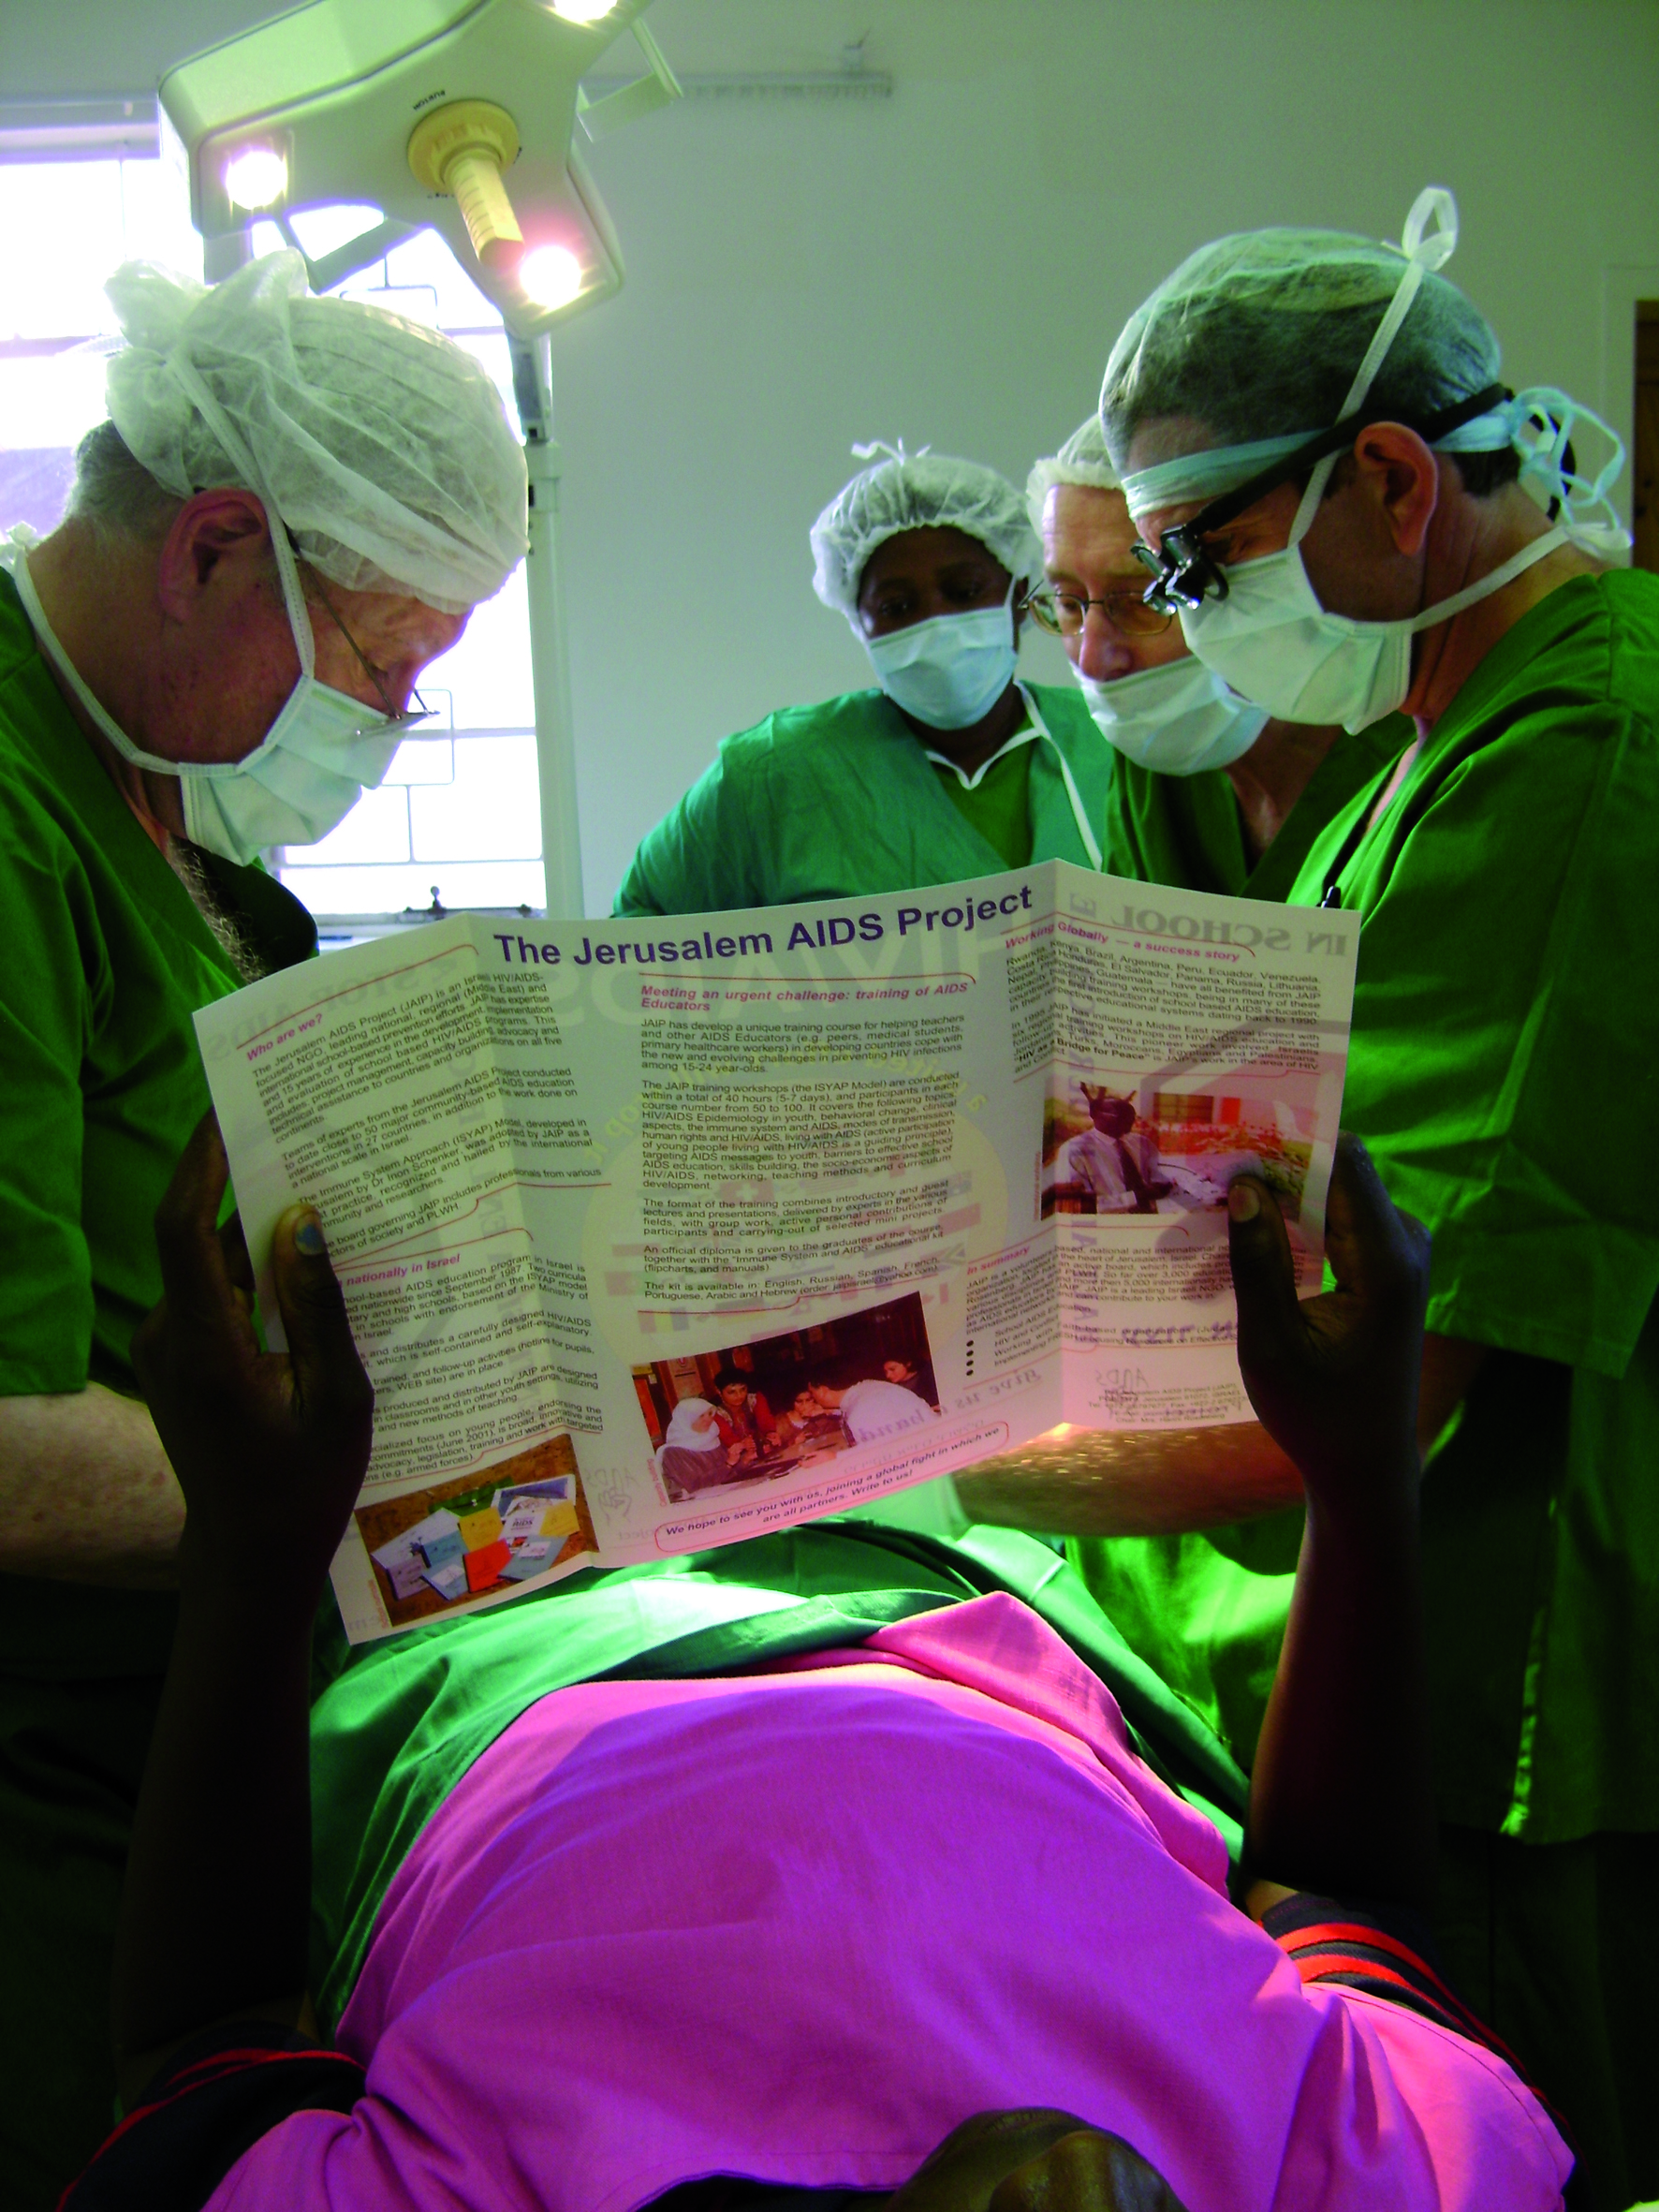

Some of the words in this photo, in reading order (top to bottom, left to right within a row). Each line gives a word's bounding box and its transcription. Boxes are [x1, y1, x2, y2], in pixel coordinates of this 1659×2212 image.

[492, 934, 561, 965] The
[573, 932, 773, 966] Jerusalem
[786, 913, 885, 951] AIDS
[897, 885, 1033, 936] Project
[1006, 926, 1054, 948] Working
[1058, 922, 1108, 944] Globally
[1145, 943, 1200, 957] success
[1204, 950, 1240, 964] story
[507, 995, 550, 1005] expertise
[640, 985, 696, 1000] Meeting
[724, 989, 771, 1002] urgent
[855, 987, 909, 999] training
[915, 985, 930, 995] of
[933, 981, 967, 994] AIDS
[641, 998, 711, 1010] Educators
[253, 1063, 272, 1077] The
[274, 1035, 326, 1066] Jerusalem
[329, 1021, 356, 1039] AIDS
[359, 1007, 397, 1026] Project
[435, 991, 446, 1000] is
[448, 984, 461, 995] an
[492, 972, 543, 981] HIV/AIDS-
[536, 1014, 556, 1023] This
[640, 1019, 666, 1028] JAIP
[668, 1021, 688, 1029] has
[690, 1021, 733, 1033] develop
[743, 1023, 781, 1033] unique
[783, 1023, 823, 1033] training
[880, 1018, 918, 1029] helping
[920, 1015, 964, 1025] teachers
[247, 1041, 273, 1060] Who
[276, 1029, 295, 1045] are
[298, 1014, 322, 1034] we?
[640, 1030, 662, 1039] and
[666, 1031, 695, 1040] other
[699, 1032, 730, 1040] AIDS
[865, 1028, 910, 1039] medical
[640, 1041, 681, 1053] primary
[683, 1042, 741, 1051] healthcare
[801, 1042, 861, 1053] developing
[862, 1040, 912, 1049] countries
[914, 1038, 941, 1047] cope
[942, 1033, 962, 1043] with
[641, 1063, 681, 1072] among
[682, 1062, 713, 1071] 15-24
[526, 1078, 575, 1086] education
[641, 1081, 663, 1089] The
[664, 1082, 689, 1090] JAIP
[692, 1083, 731, 1094] training
[732, 1084, 788, 1094] workshops
[814, 1082, 849, 1091] ISYAP
[907, 1070, 959, 1084] conducted
[641, 1092, 672, 1100] within
[684, 1093, 709, 1101] total
[835, 1091, 856, 1099] and
[859, 1086, 918, 1100] participants
[921, 1084, 931, 1093] in
[933, 1080, 959, 1091] each
[980, 1246, 1030, 1271] summary
[346, 1266, 407, 1285] nationally
[411, 1264, 422, 1274] in
[426, 1254, 460, 1270] Israel
[547, 1311, 591, 1326] HIV/AIDS
[378, 1421, 397, 1432] and
[399, 1420, 419, 1428] new
[421, 1408, 464, 1424] methods
[465, 1405, 476, 1414] of
[476, 1397, 517, 1412] teaching
[417, 1432, 445, 1442] focus
[464, 1422, 495, 1436] young
[667, 1524, 686, 1534] We
[687, 1518, 717, 1530] hope
[719, 1514, 730, 1523] to
[732, 1510, 753, 1520] see
[755, 1503, 777, 1517] you
[778, 1495, 803, 1508] with
[824, 1479, 863, 1499] joining
[873, 1461, 908, 1484] global
[910, 1451, 935, 1468] fight
[938, 1449, 947, 1457] in
[950, 1433, 981, 1453] which
[984, 1428, 999, 1439] we
[763, 1512, 781, 1521] are
[782, 1505, 797, 1517] all
[851, 1482, 881, 1496] Write
[882, 1478, 894, 1486] to
[895, 1469, 913, 1482] us!
